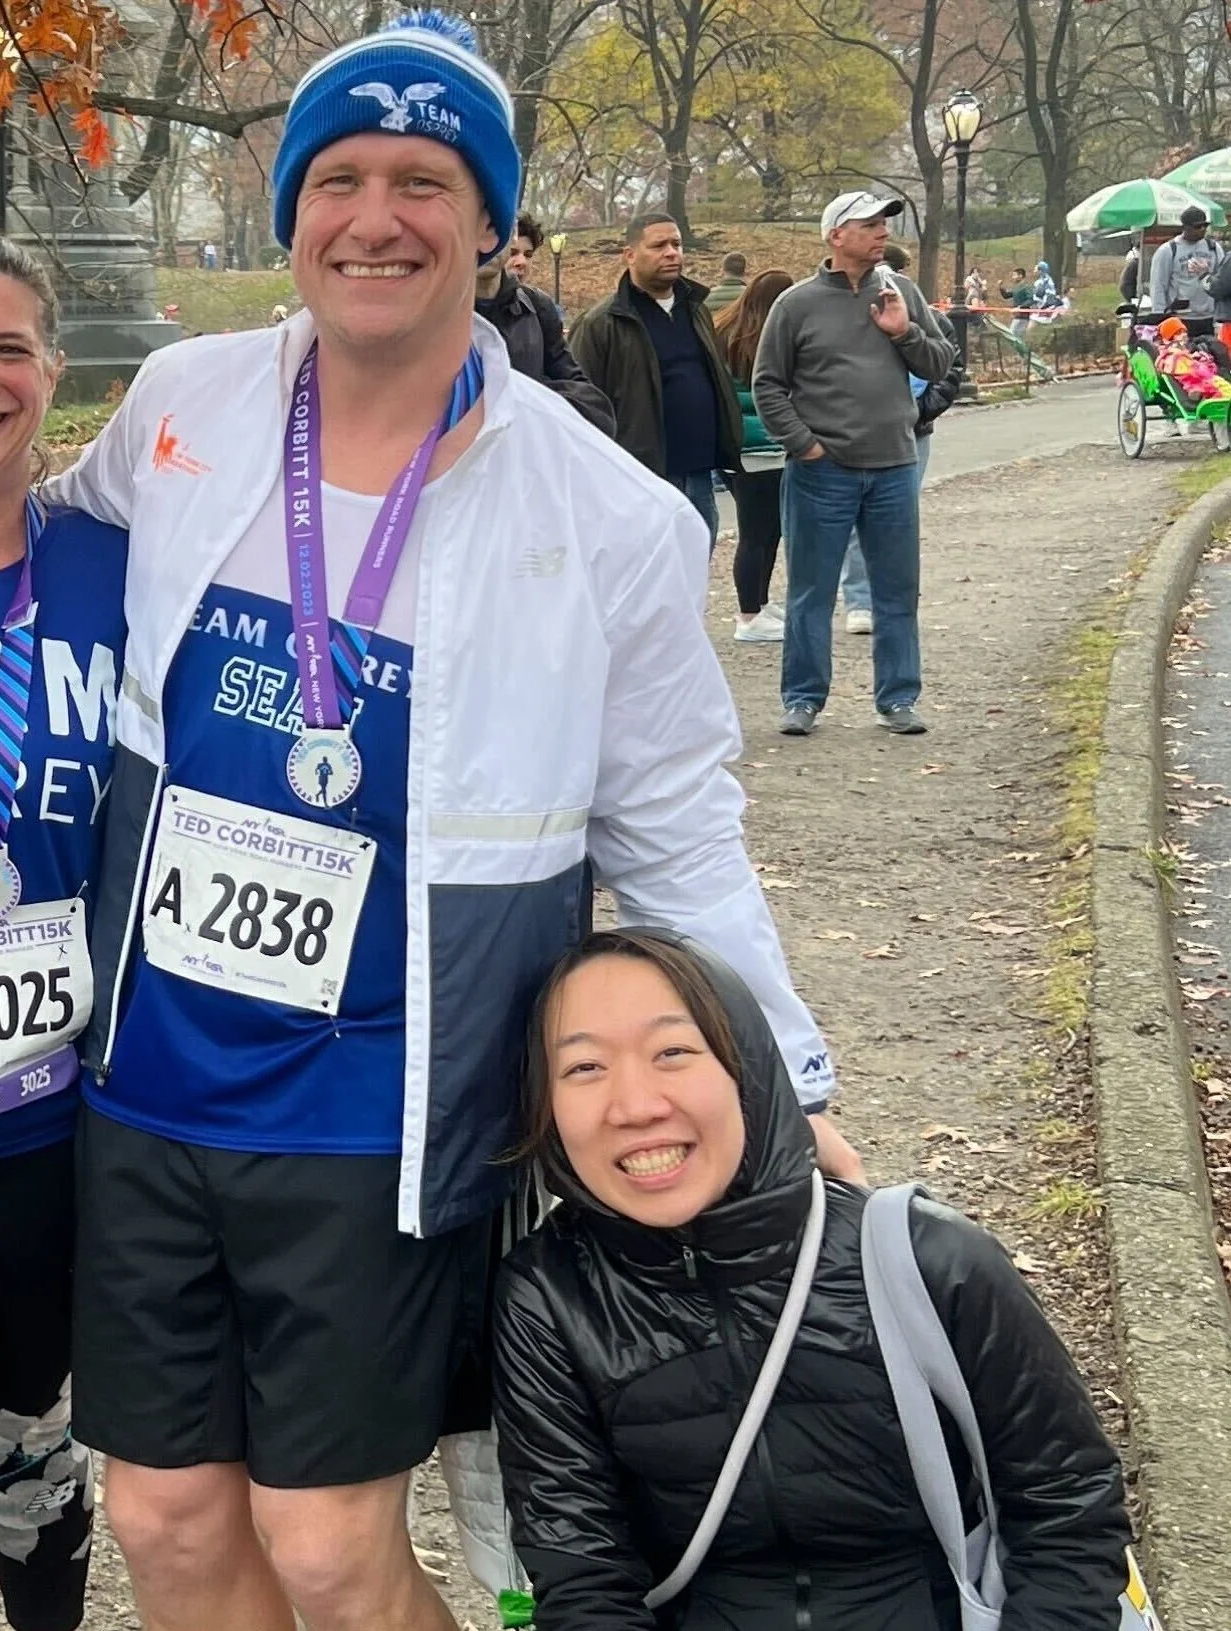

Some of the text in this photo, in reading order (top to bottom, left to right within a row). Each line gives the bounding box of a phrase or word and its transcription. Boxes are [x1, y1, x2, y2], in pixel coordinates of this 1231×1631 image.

[415, 102, 461, 131] TEAM
[292, 391, 309, 479] CORBITT
[293, 487, 311, 528] 15K
[173, 811, 211, 835] TED
[150, 866, 334, 965] A 2838
[20, 1065, 51, 1097] 3025
